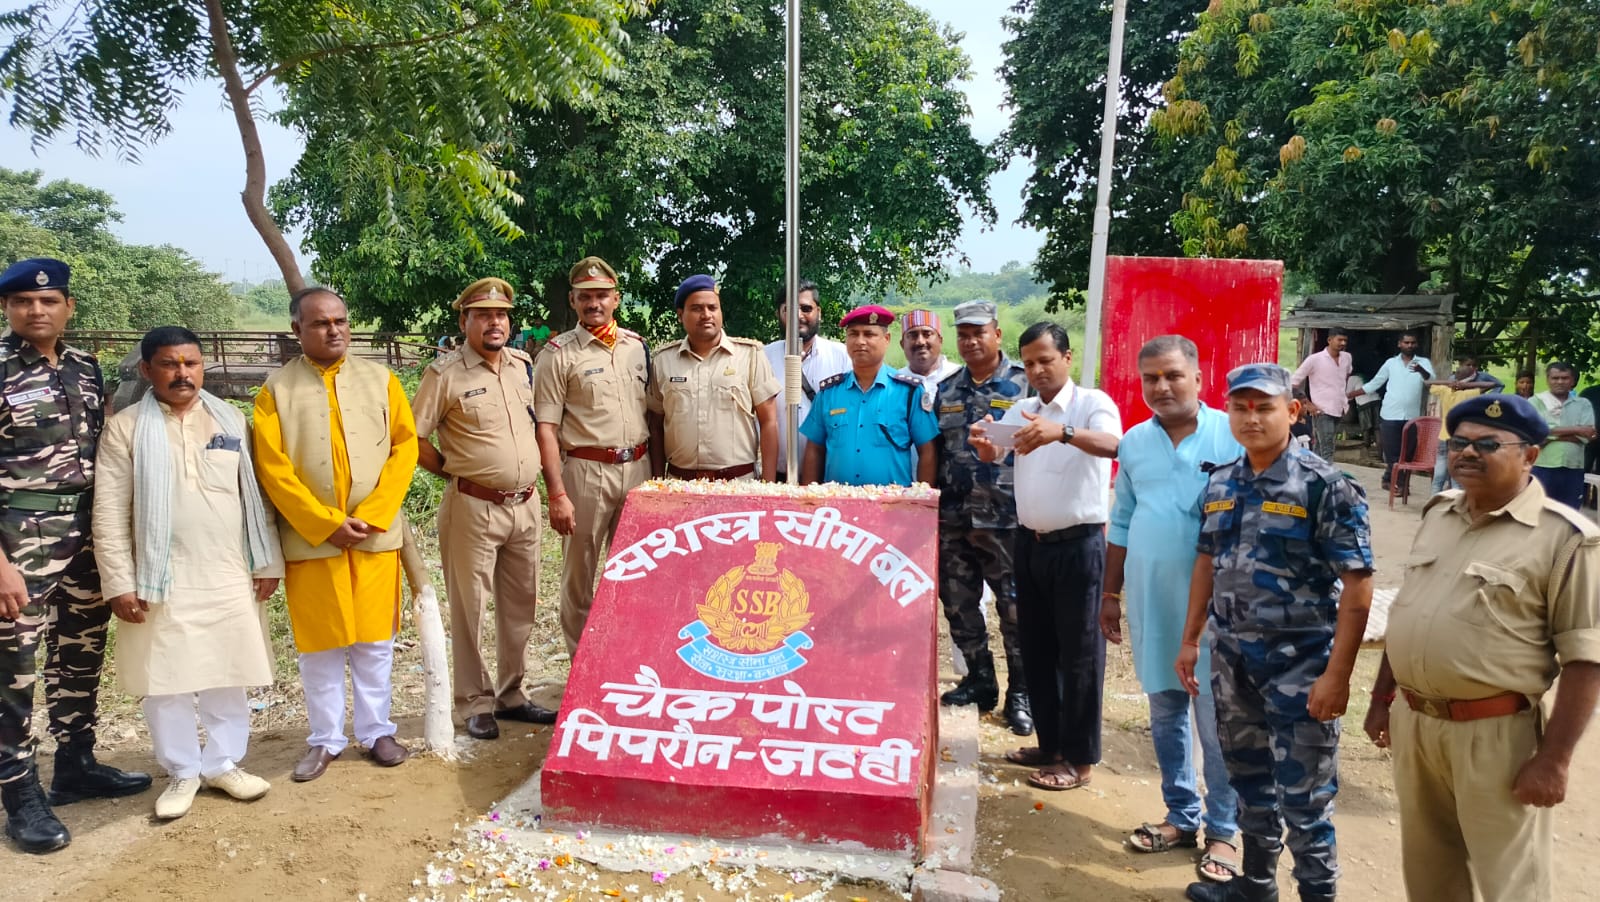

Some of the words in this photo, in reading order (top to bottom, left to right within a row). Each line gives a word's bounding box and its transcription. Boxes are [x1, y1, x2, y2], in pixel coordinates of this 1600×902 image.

[603, 510, 767, 581] सशस्त्र
[869, 543, 935, 608] बल
[734, 588, 782, 616] SSB
[745, 679, 896, 736] पोस्ट
